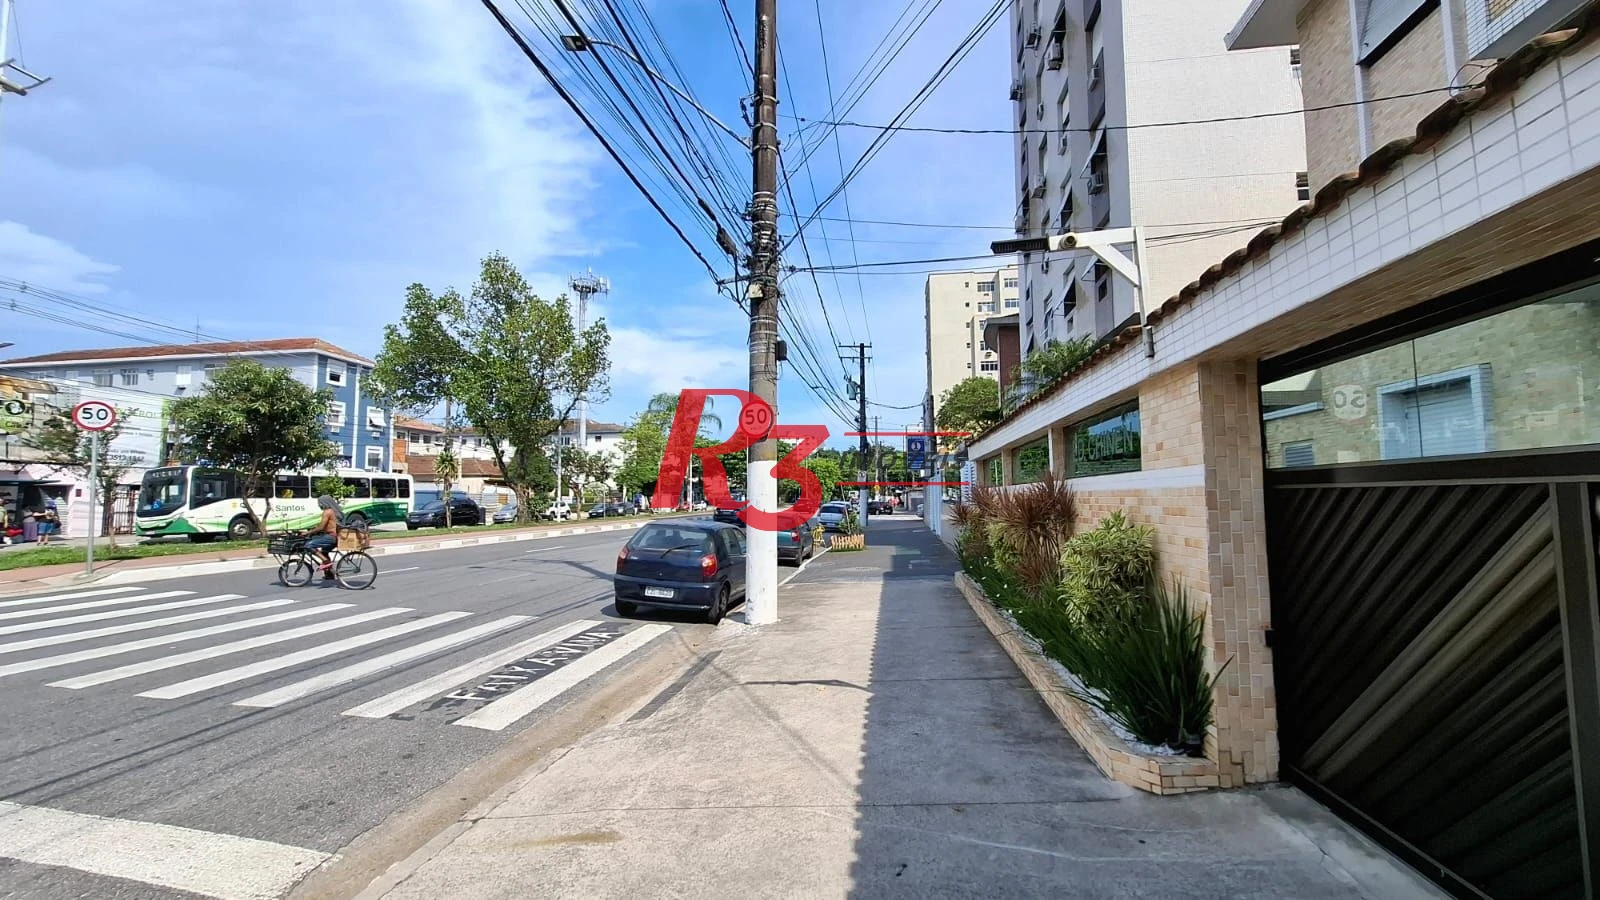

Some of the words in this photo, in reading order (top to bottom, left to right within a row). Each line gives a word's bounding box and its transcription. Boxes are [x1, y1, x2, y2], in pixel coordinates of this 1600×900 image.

[82, 408, 108, 420] 50
[745, 409, 767, 425] 50
[275, 504, 305, 512] Santos
[445, 658, 569, 700] FAIXA
